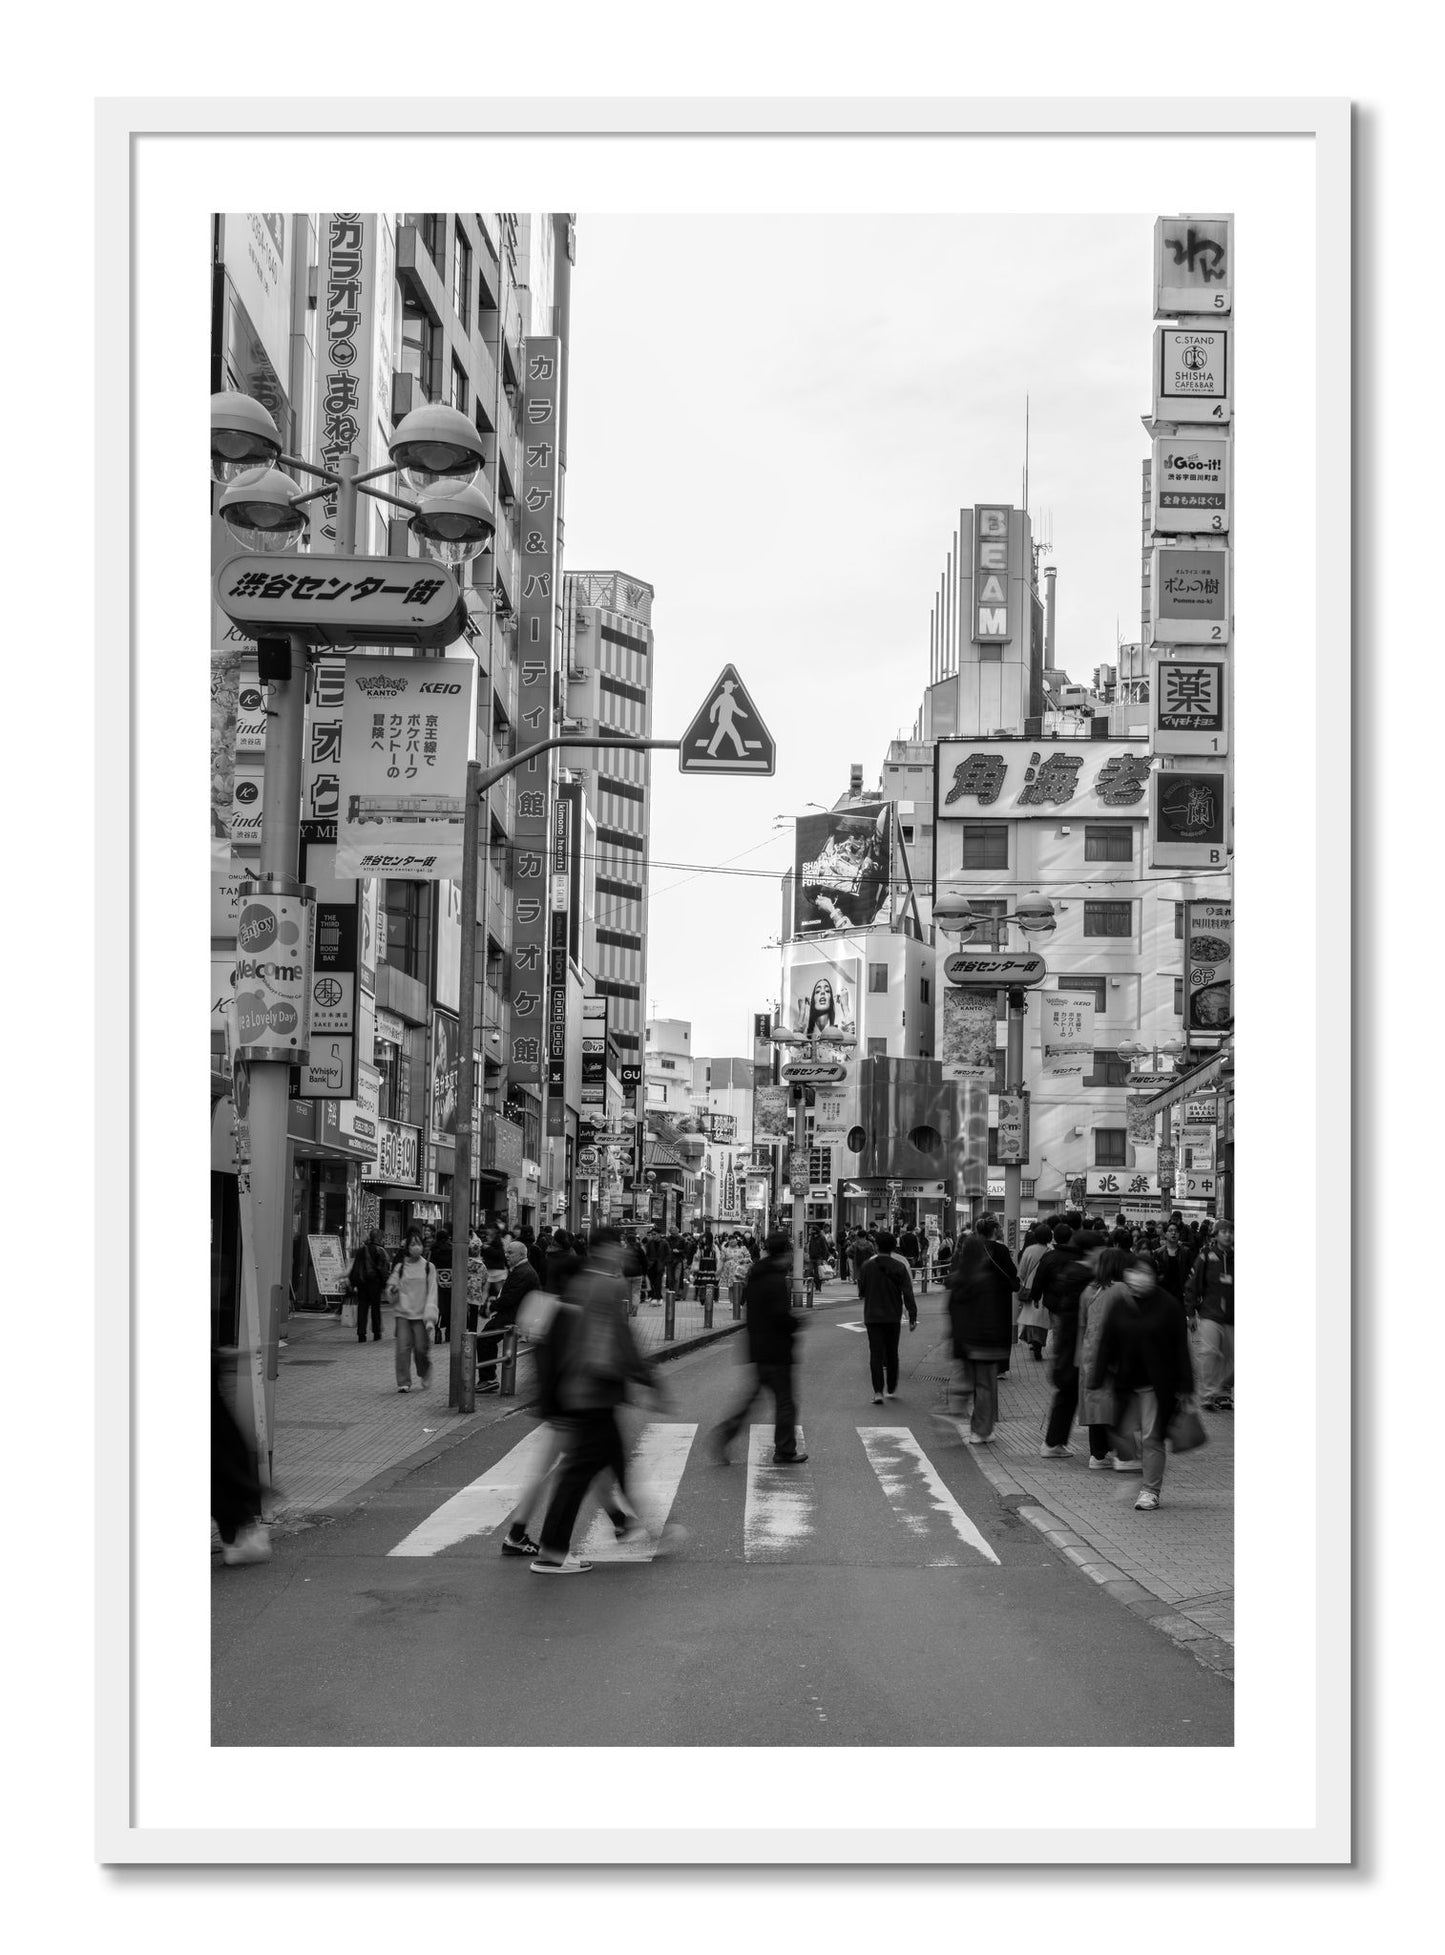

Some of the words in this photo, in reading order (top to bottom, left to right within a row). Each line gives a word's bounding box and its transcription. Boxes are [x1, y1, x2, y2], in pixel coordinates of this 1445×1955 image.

[327, 221, 363, 340] カラオケ
[1214, 295, 1225, 308] 5
[1175, 336, 1214, 345] C.STAND
[1175, 371, 1214, 381] SHISHA
[1212, 404, 1224, 418] 4
[1173, 456, 1222, 471] Goo-it!
[1212, 515, 1223, 530] 3
[978, 509, 1007, 635] BEAM
[228, 572, 445, 606] 渋谷センター街
[1211, 626, 1222, 640] 2
[419, 682, 462, 695] KEIO
[1166, 668, 1211, 713] 薬
[1161, 715, 1216, 729] マツモトキヨシ
[370, 713, 386, 751] 冒険へ
[386, 713, 402, 779] カントーの
[423, 714, 439, 767] 京王線で
[1210, 738, 1219, 752] 1
[944, 752, 1155, 806] 角海老
[1162, 785, 1216, 829] 一蘭
[557, 804, 566, 835] kimono
[359, 855, 438, 868] 渋谷センター街
[1209, 849, 1220, 864] B
[240, 915, 275, 946] Enjoy
[511, 853, 543, 1065] カラオケ館
[950, 961, 1040, 972] 渋谷センター街
[236, 959, 303, 981] Welcome
[1190, 968, 1216, 986] 6F
[251, 1008, 278, 1027] Lovely
[279, 1010, 296, 1023] Day!
[309, 1066, 339, 1077] Whisky
[309, 1075, 327, 1083] Bank
[622, 1070, 641, 1080] GU
